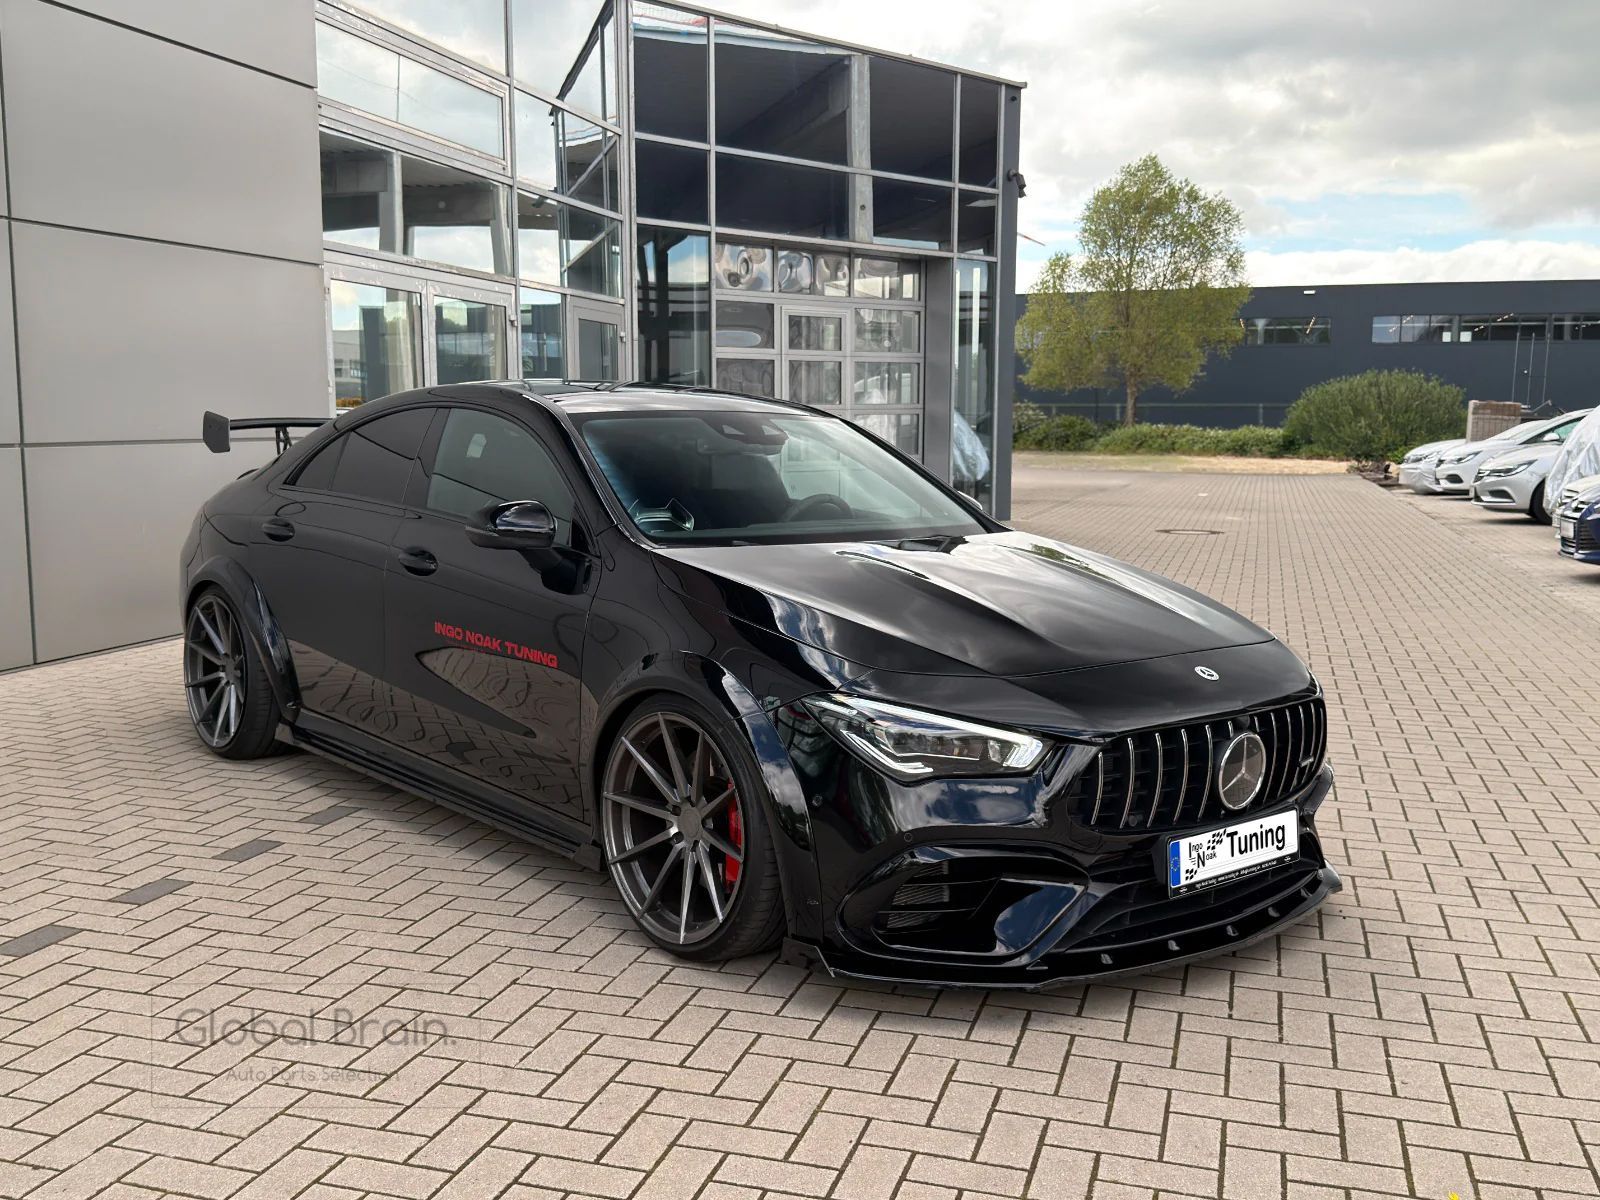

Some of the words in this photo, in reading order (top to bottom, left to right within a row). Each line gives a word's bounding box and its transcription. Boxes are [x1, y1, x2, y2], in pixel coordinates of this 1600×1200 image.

[434, 621, 463, 640] INGO
[466, 630, 502, 652] NOAK
[505, 641, 558, 668] TUNING
[1226, 824, 1286, 857] Tuning
[1197, 851, 1217, 868] Noak
